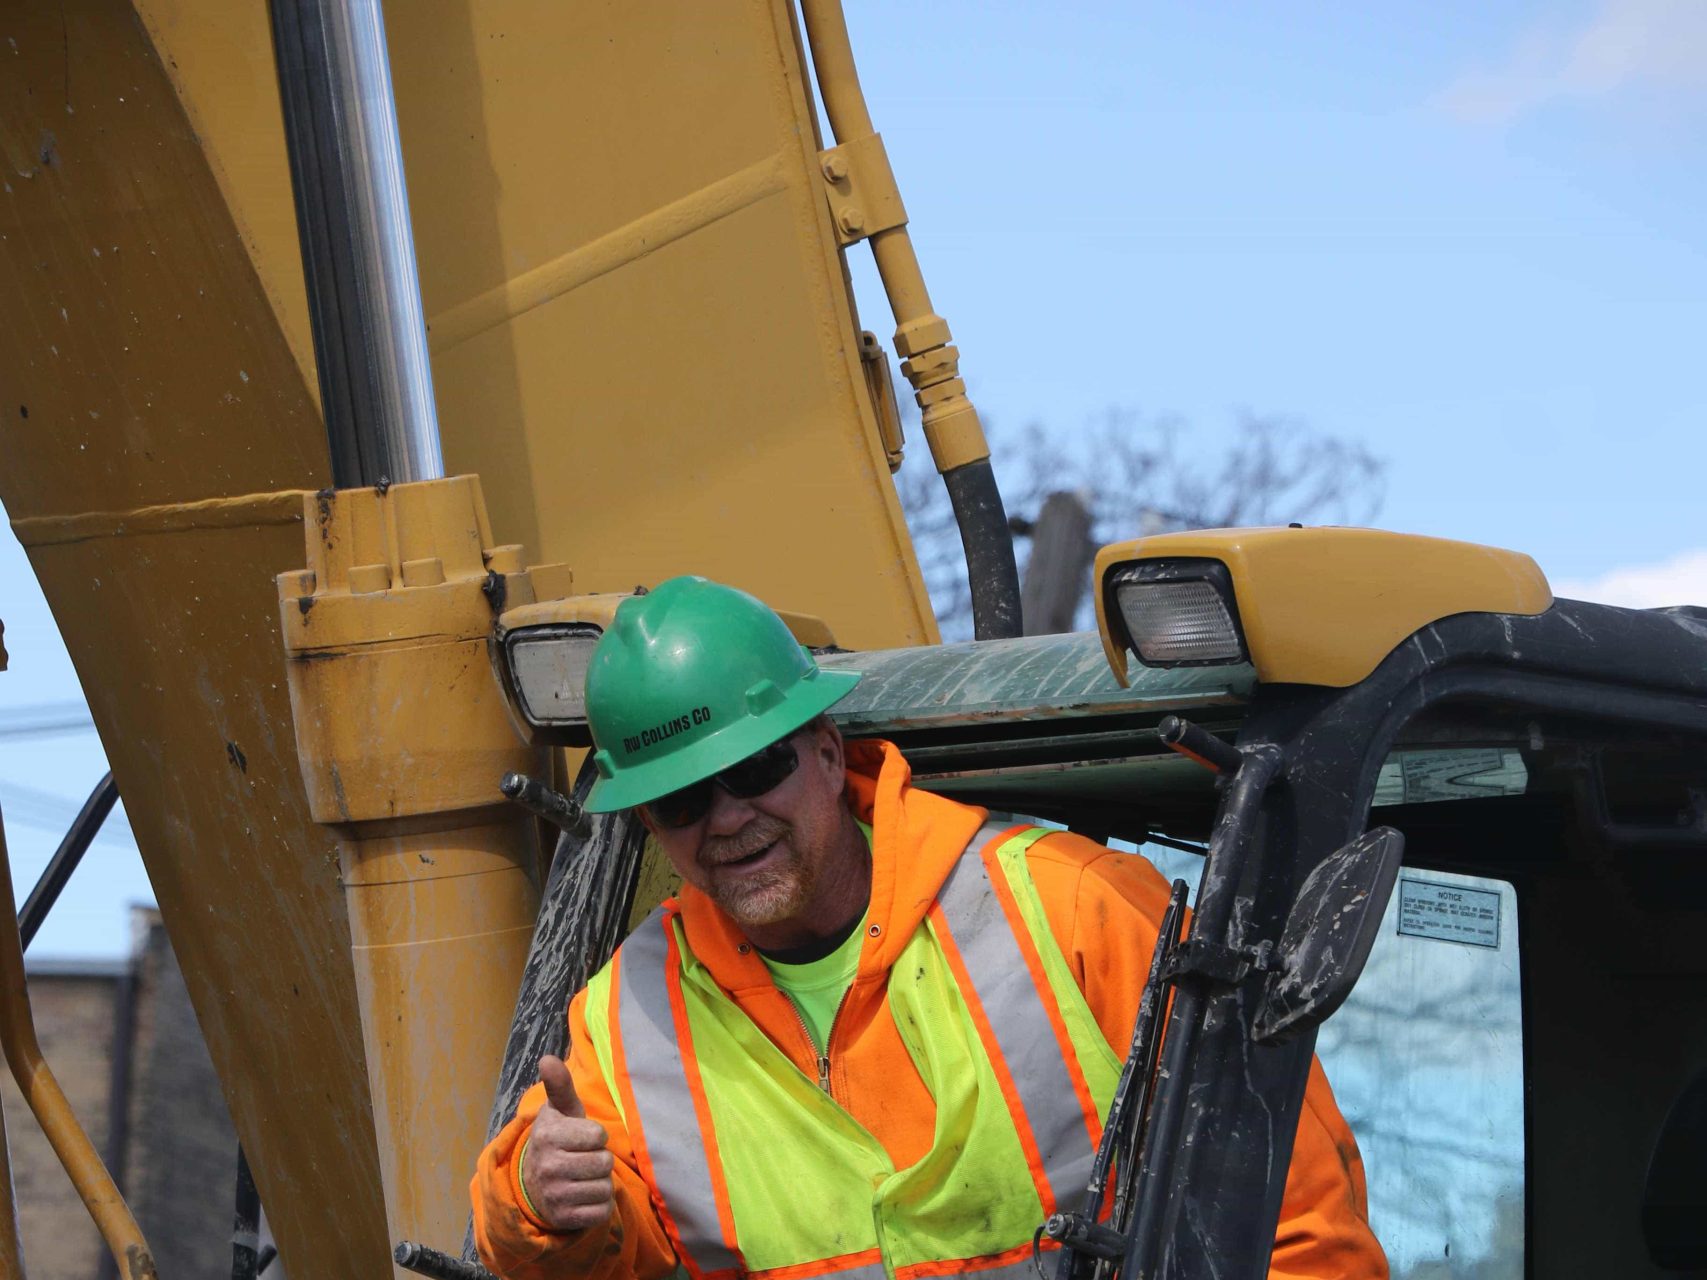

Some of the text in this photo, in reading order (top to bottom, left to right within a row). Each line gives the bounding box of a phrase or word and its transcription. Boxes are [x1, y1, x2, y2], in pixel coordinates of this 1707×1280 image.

[641, 715, 691, 747] COLLINS
[692, 706, 711, 725] CO
[1438, 892, 1462, 902] NOTICE
